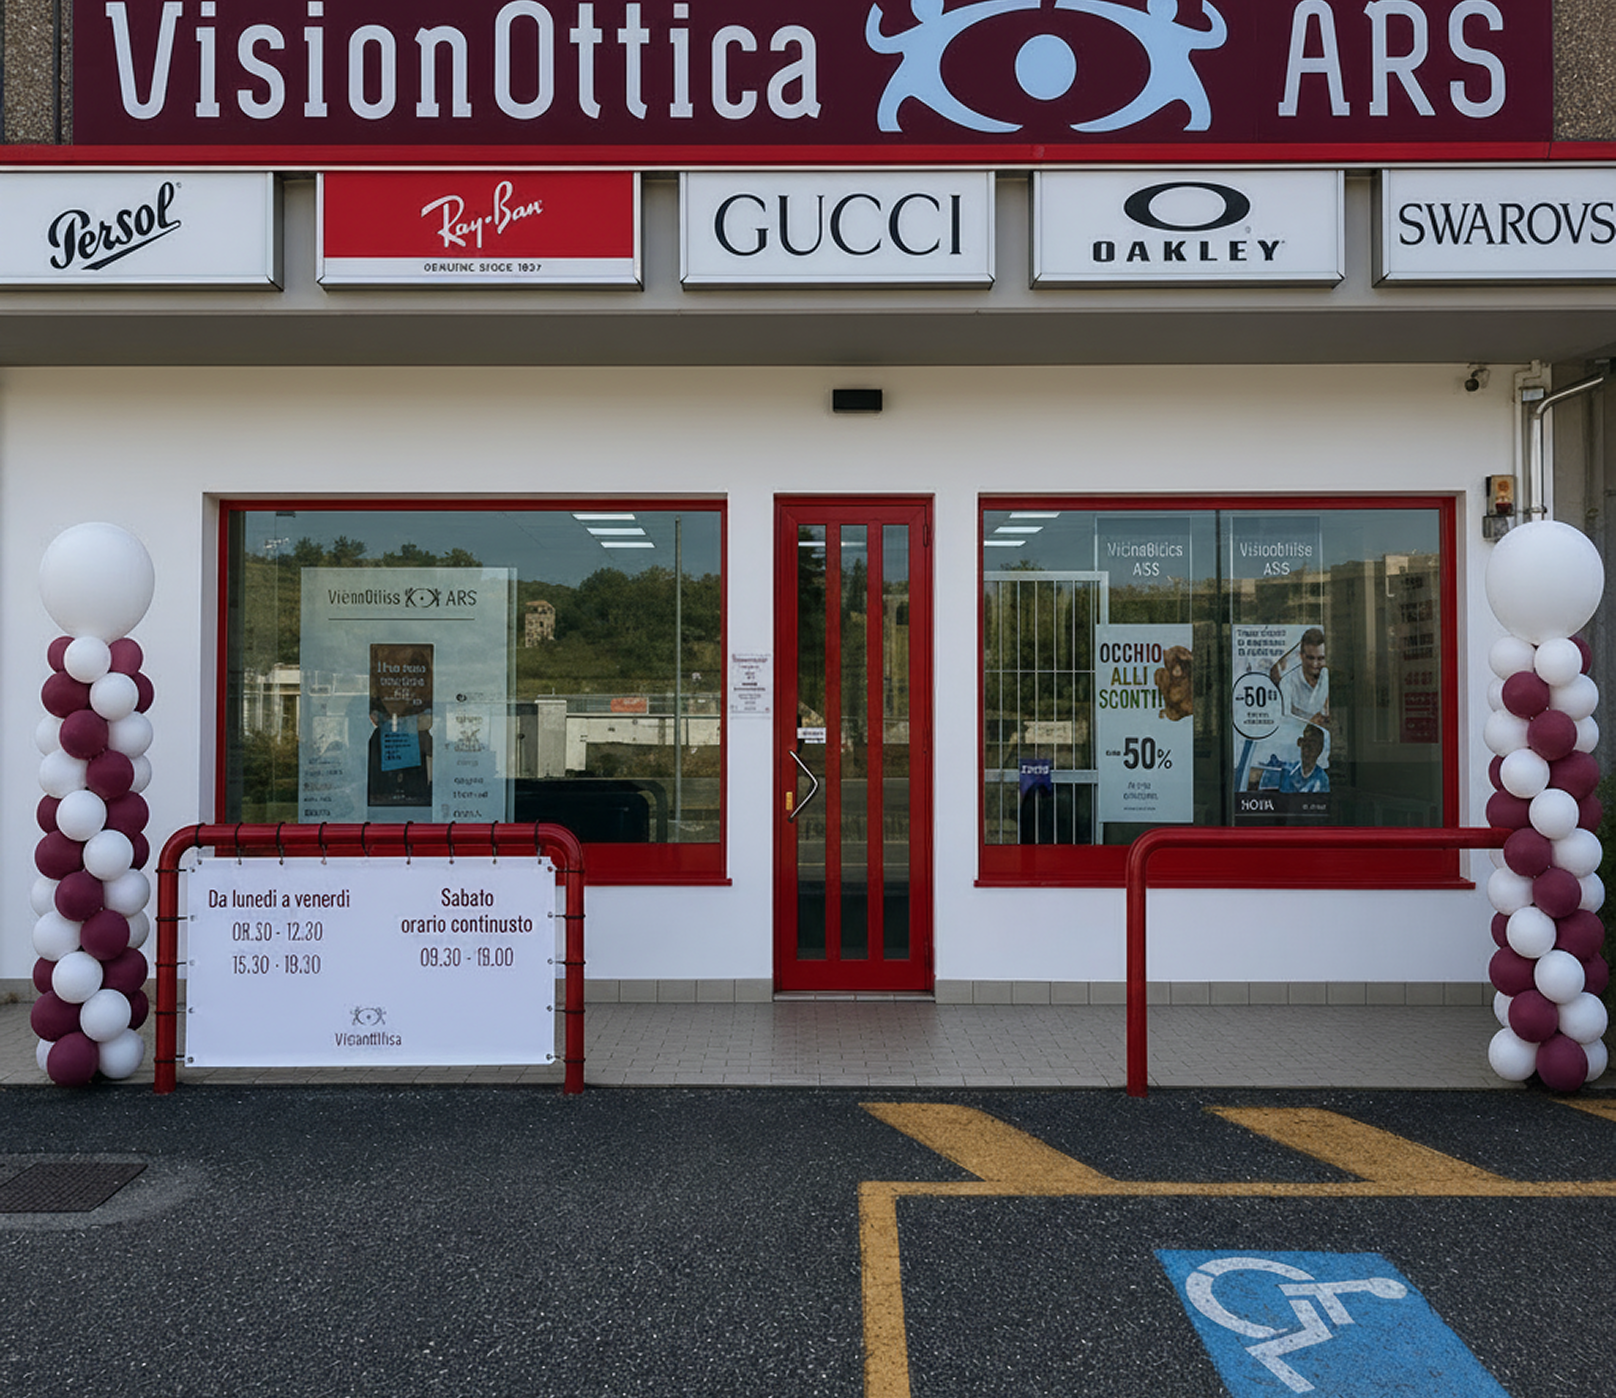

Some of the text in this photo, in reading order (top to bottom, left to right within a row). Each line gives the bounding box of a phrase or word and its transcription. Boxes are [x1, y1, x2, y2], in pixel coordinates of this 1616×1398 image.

[106, 0, 1507, 120] VisionOttica ARS
[48, 181, 182, 270] Persol
[714, 193, 962, 256] GUCCI
[1398, 202, 1616, 246] SWAROVS
[1092, 240, 1281, 263] OAKLEY
[446, 589, 478, 606] ARS
[1100, 643, 1162, 663] OCCHIO
[1111, 666, 1148, 686] ALLI
[209, 889, 350, 908] Da lunedi a venerdi
[441, 887, 494, 907] Sabato
[401, 914, 447, 933] orario
